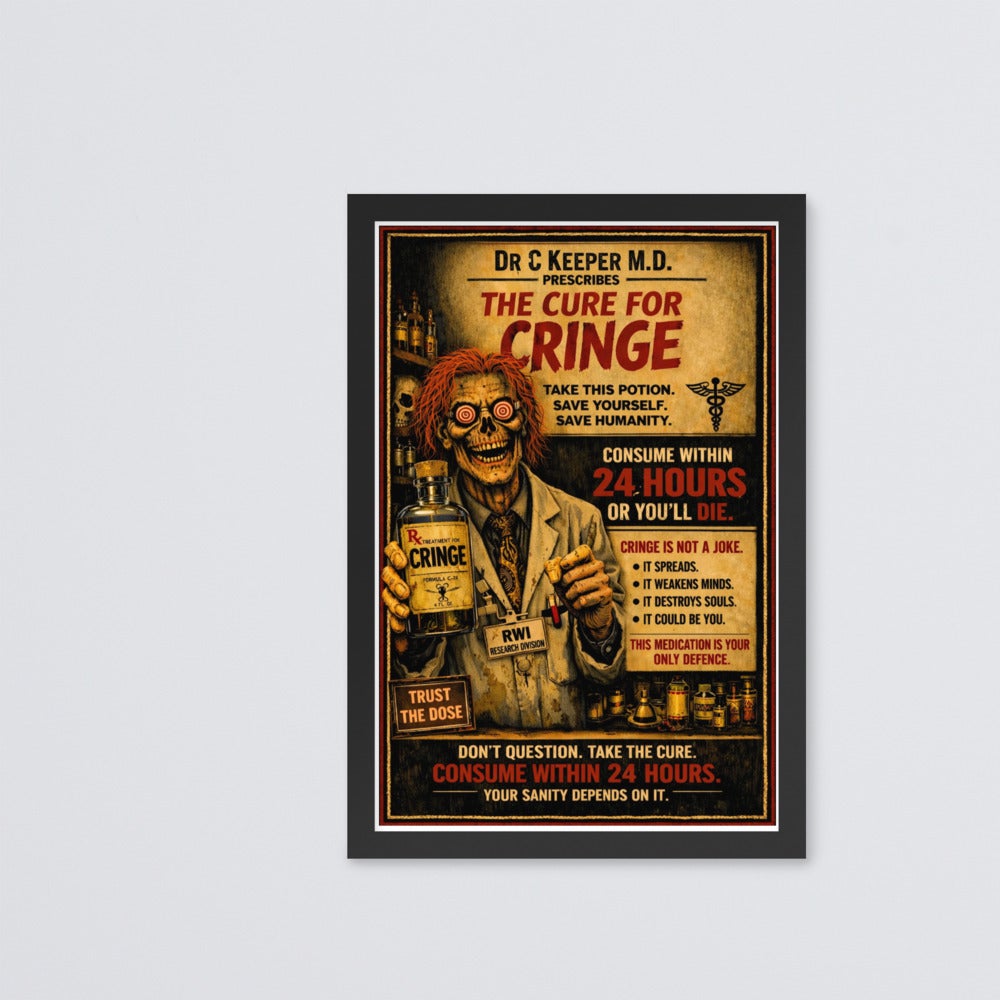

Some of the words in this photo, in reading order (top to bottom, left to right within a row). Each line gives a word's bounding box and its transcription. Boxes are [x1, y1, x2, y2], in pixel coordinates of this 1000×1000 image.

[528, 249, 542, 272] C
[628, 249, 673, 272] M.D.
[542, 274, 620, 286] PRESCRIBES
[481, 291, 534, 317] THE
[542, 291, 618, 317] CURE
[625, 290, 683, 317] FOR
[500, 319, 684, 374] CRINGE
[543, 384, 579, 396] TAKE
[582, 384, 615, 396] THIS
[618, 384, 675, 396] POTION.
[553, 400, 589, 411] SAVE
[592, 400, 668, 411] YOURSELF.
[556, 415, 592, 426] SAVE
[595, 415, 672, 426] HUMANITY.
[602, 447, 675, 463] CONSUME
[679, 447, 733, 463] WITHIN
[592, 467, 636, 497] 24
[643, 467, 747, 498] HOURS
[607, 503, 630, 521] OR
[697, 503, 734, 521] DIE.
[620, 541, 660, 554] CRINGE
[663, 541, 674, 554] IS
[677, 541, 699, 554] NOT
[702, 541, 710, 554] A
[713, 541, 743, 554] JOKE.
[409, 545, 467, 569] CRINGE
[643, 561, 652, 573] IT
[654, 561, 699, 573] SPREADS.
[643, 578, 652, 590] IT
[654, 578, 699, 590] WEAKENS
[702, 578, 734, 590] MINDS.
[643, 596, 652, 607] IT
[654, 596, 702, 607] DESTROYS
[704, 596, 737, 607] SOULS.
[643, 613, 652, 625] IT
[654, 613, 687, 625] COULD
[689, 613, 701, 625] BE
[703, 613, 726, 625] YOU.
[502, 626, 531, 643] RWI
[490, 644, 518, 655] RESEARCH
[520, 640, 545, 650] DIVISION
[630, 639, 651, 650] THIS
[654, 639, 710, 650] MEDICATION
[713, 639, 723, 650] IS
[725, 639, 750, 650] YOUR
[653, 654, 679, 665] ONLY
[683, 654, 731, 665] DEFENCE.
[408, 687, 451, 704] TRUST
[400, 709, 426, 724] THE
[429, 705, 464, 721] DOSE
[458, 745, 501, 759] DON'T
[505, 745, 583, 760] QUESTION.
[588, 745, 622, 759] TAKE
[626, 745, 653, 759] THE
[656, 745, 697, 759] CURE.
[432, 763, 527, 783] CONSUME
[532, 763, 600, 783] WITHIN
[607, 763, 637, 783] 24
[644, 763, 721, 783] HOURS.
[484, 789, 518, 802] YOUR
[522, 789, 568, 802] SANITY
[571, 789, 628, 802] DEPENDS
[631, 789, 649, 802] ON
[653, 789, 669, 802] IT.
